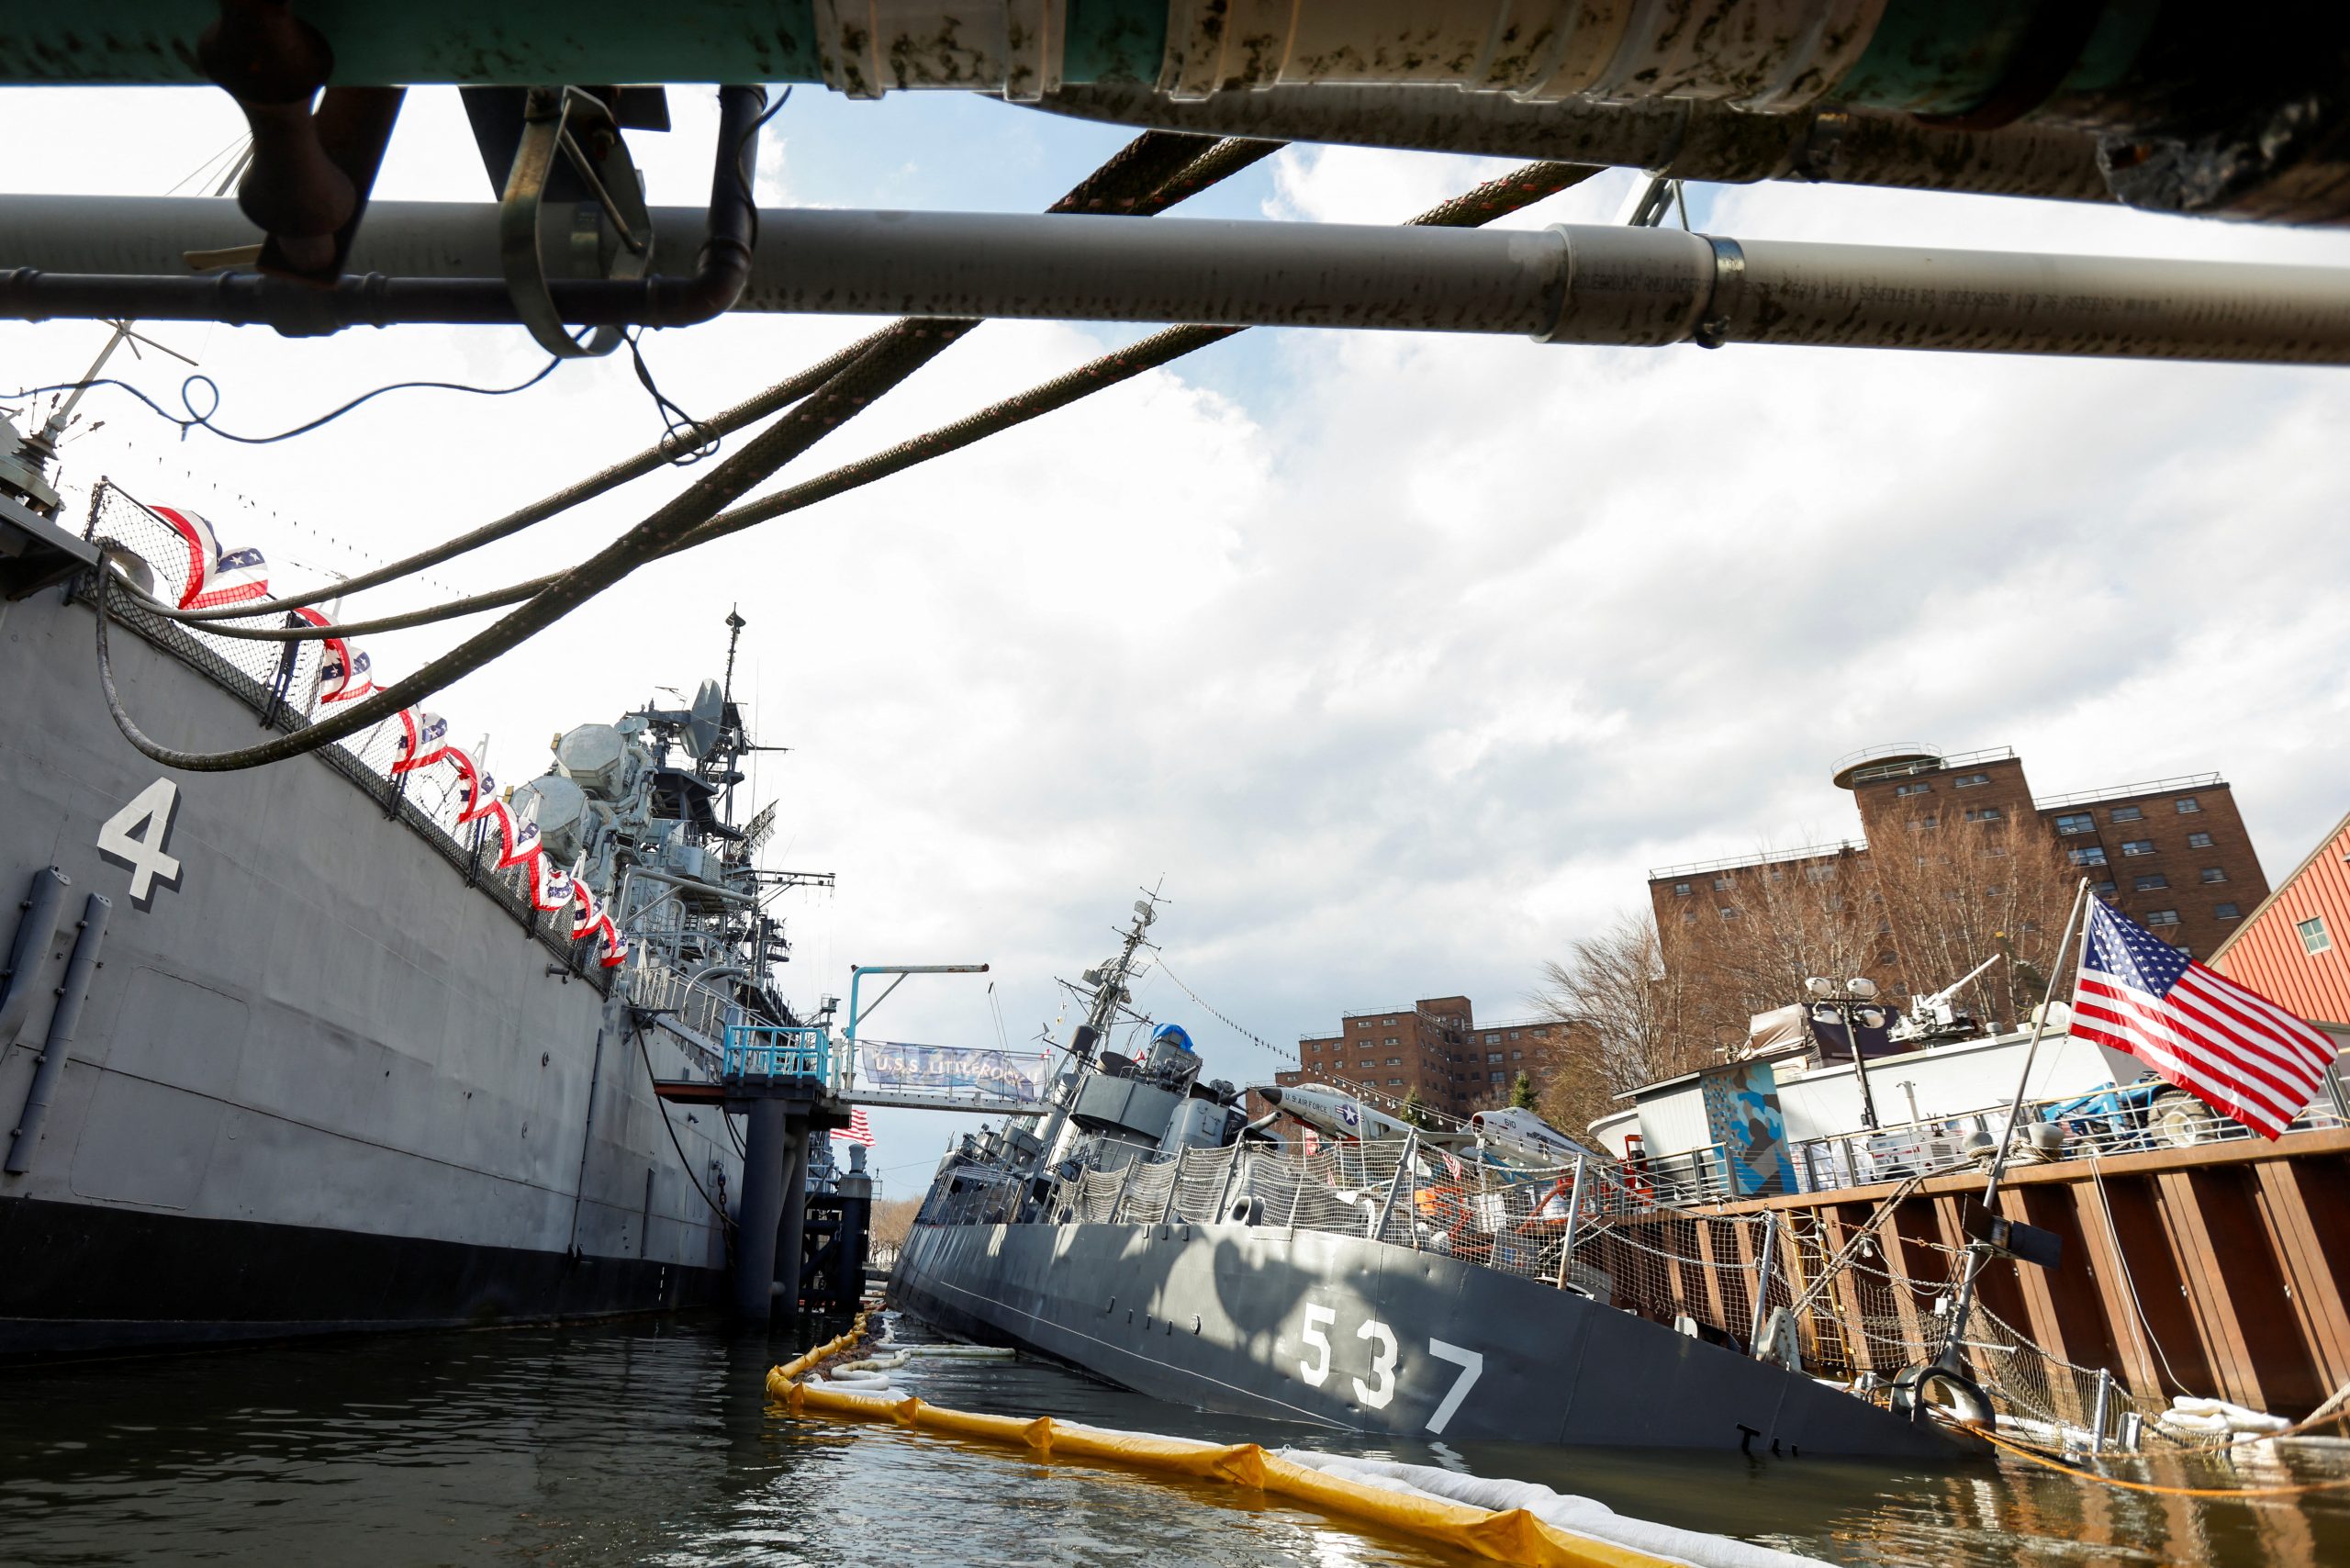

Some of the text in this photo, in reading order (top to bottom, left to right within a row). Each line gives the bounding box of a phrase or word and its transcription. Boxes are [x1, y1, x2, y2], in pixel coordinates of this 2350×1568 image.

[97, 777, 181, 903] 4
[1298, 1097, 1308, 1107] AIR
[1308, 1101, 1328, 1114] FORCE
